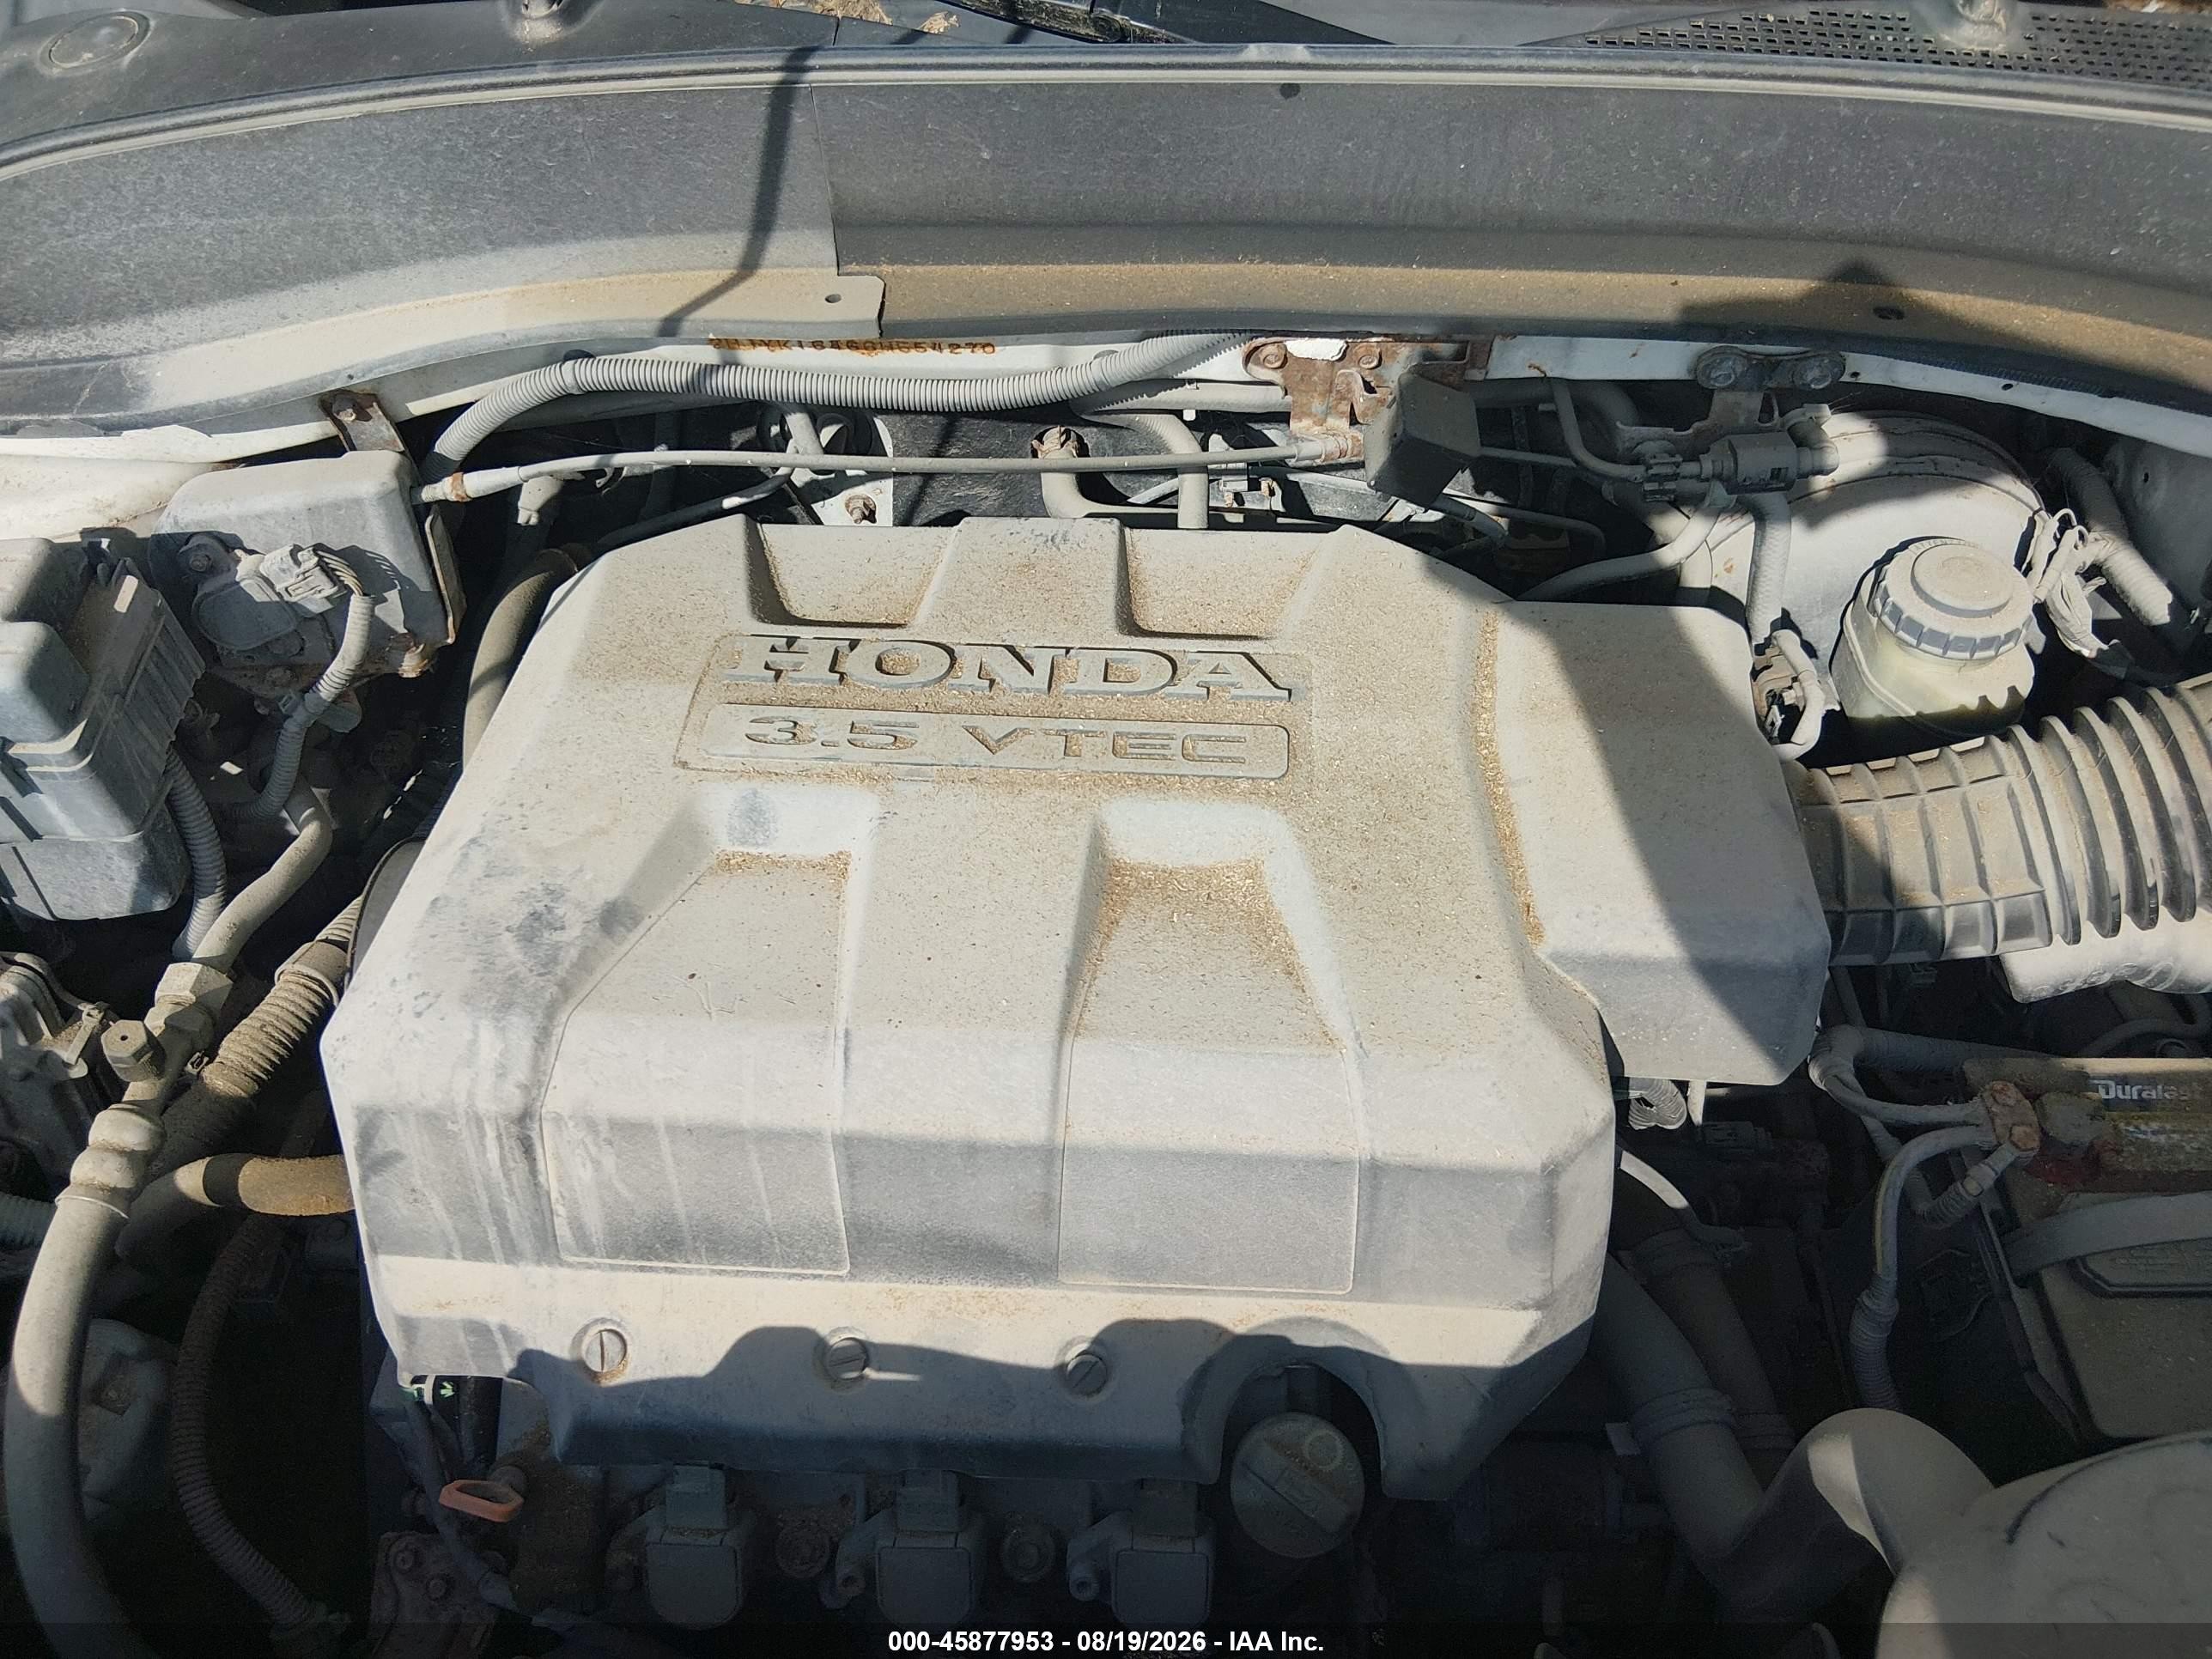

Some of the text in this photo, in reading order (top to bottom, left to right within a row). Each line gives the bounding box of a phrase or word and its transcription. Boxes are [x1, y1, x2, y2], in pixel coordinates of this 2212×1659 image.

[722, 634, 1296, 702] HONDA
[744, 716, 1248, 763] 3.5 VTEC
[2088, 1079, 2200, 1100] Durala
